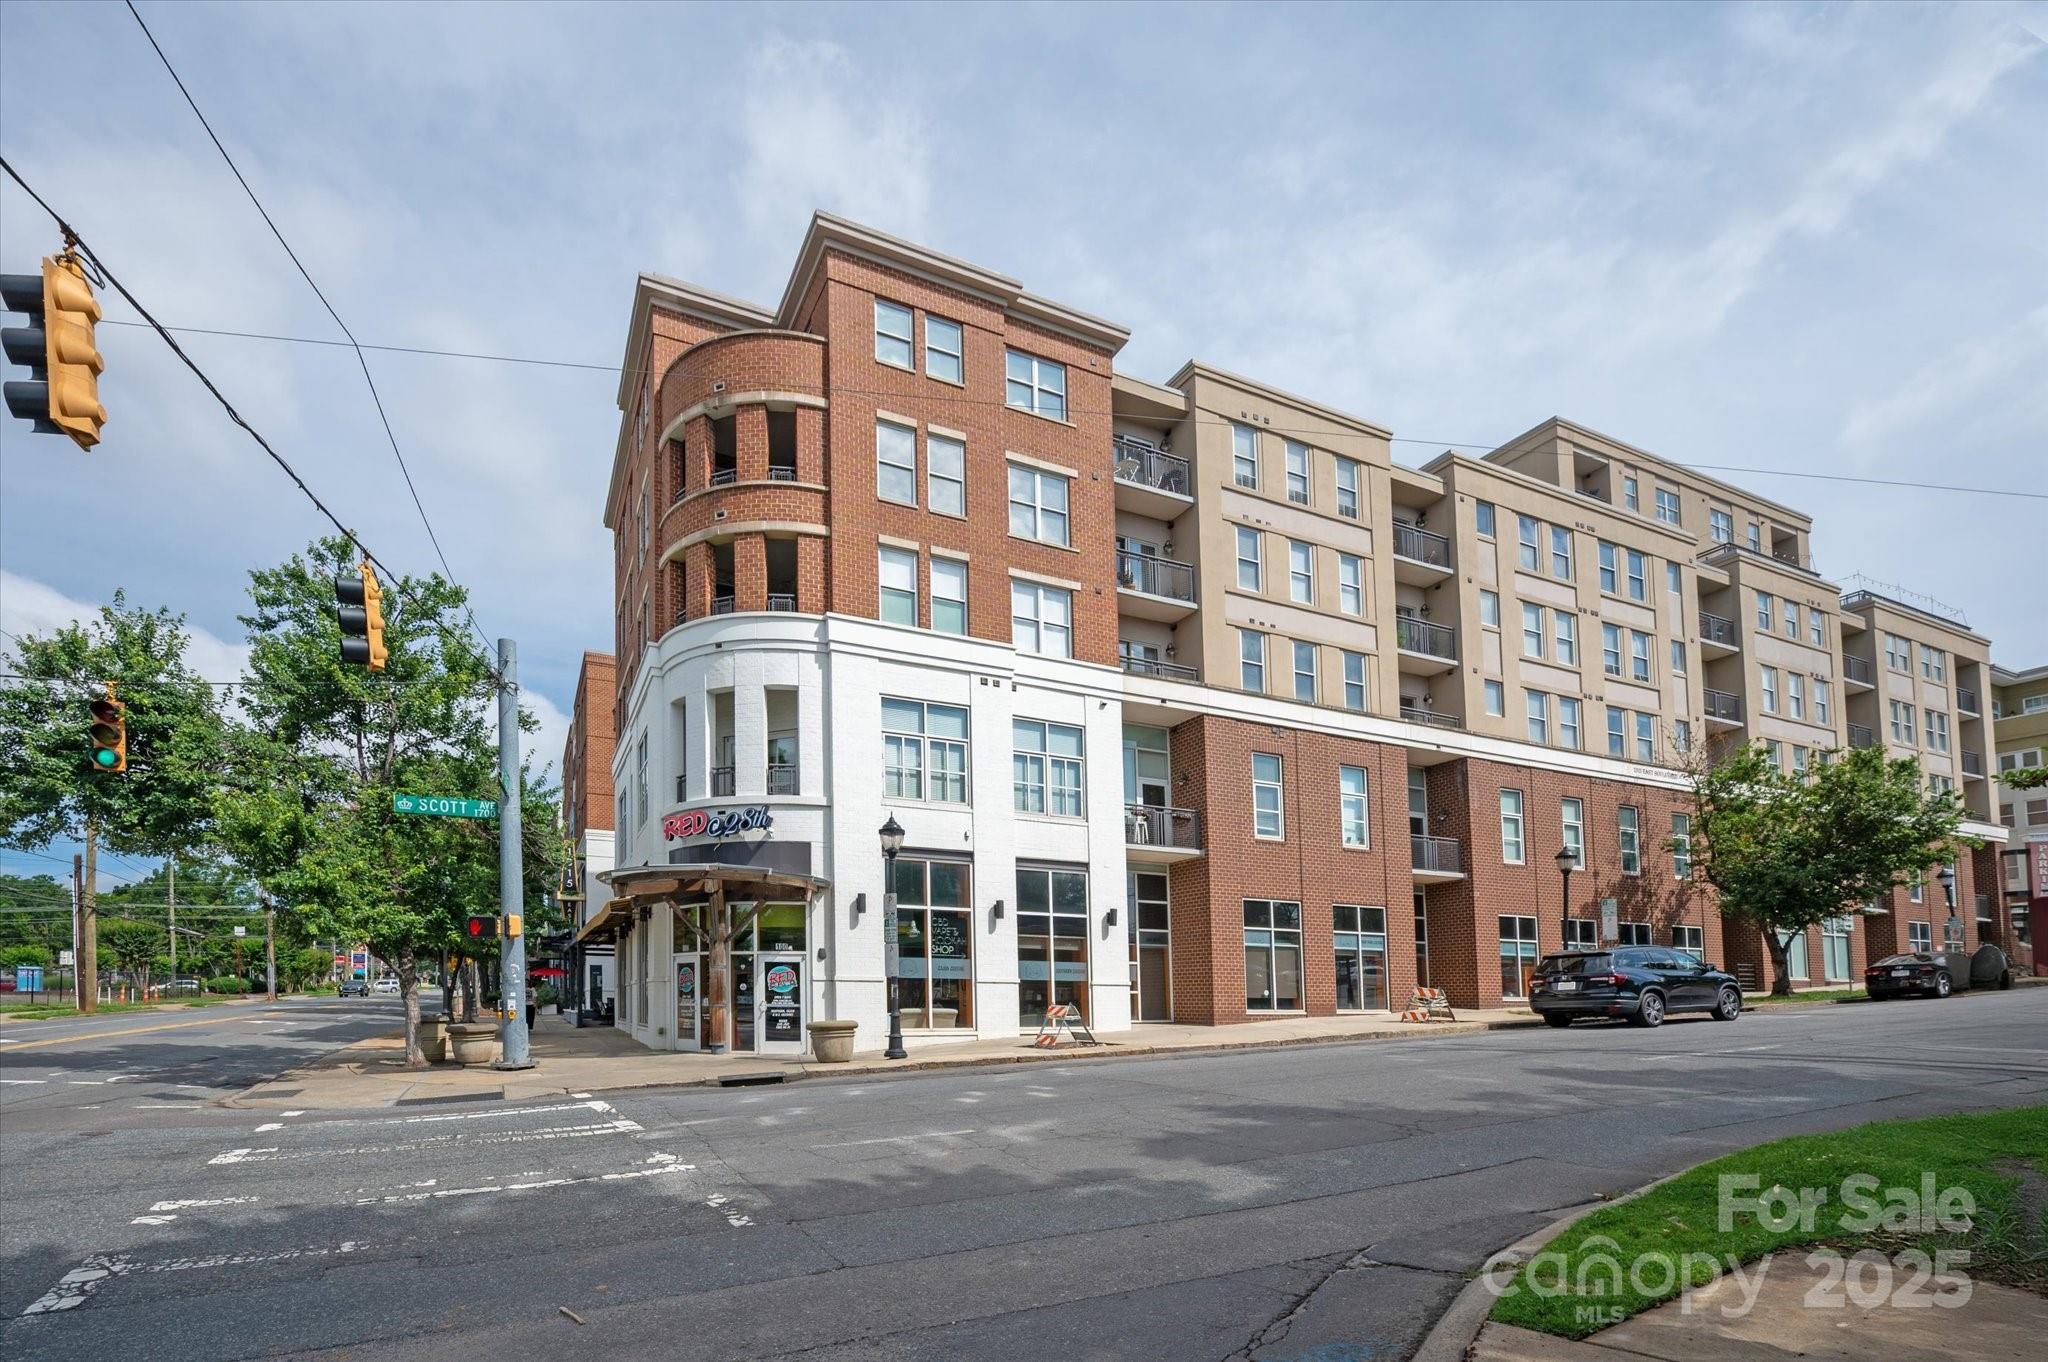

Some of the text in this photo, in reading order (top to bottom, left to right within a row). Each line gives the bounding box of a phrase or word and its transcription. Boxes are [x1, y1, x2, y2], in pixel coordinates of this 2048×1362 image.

[419, 799, 496, 814] SCOTT AVE
[475, 809, 496, 818] 1700
[663, 809, 708, 841] RED
[2038, 844, 2048, 896] PARKIN
[932, 927, 952, 937] VAPE
[932, 945, 955, 955] SHOP
